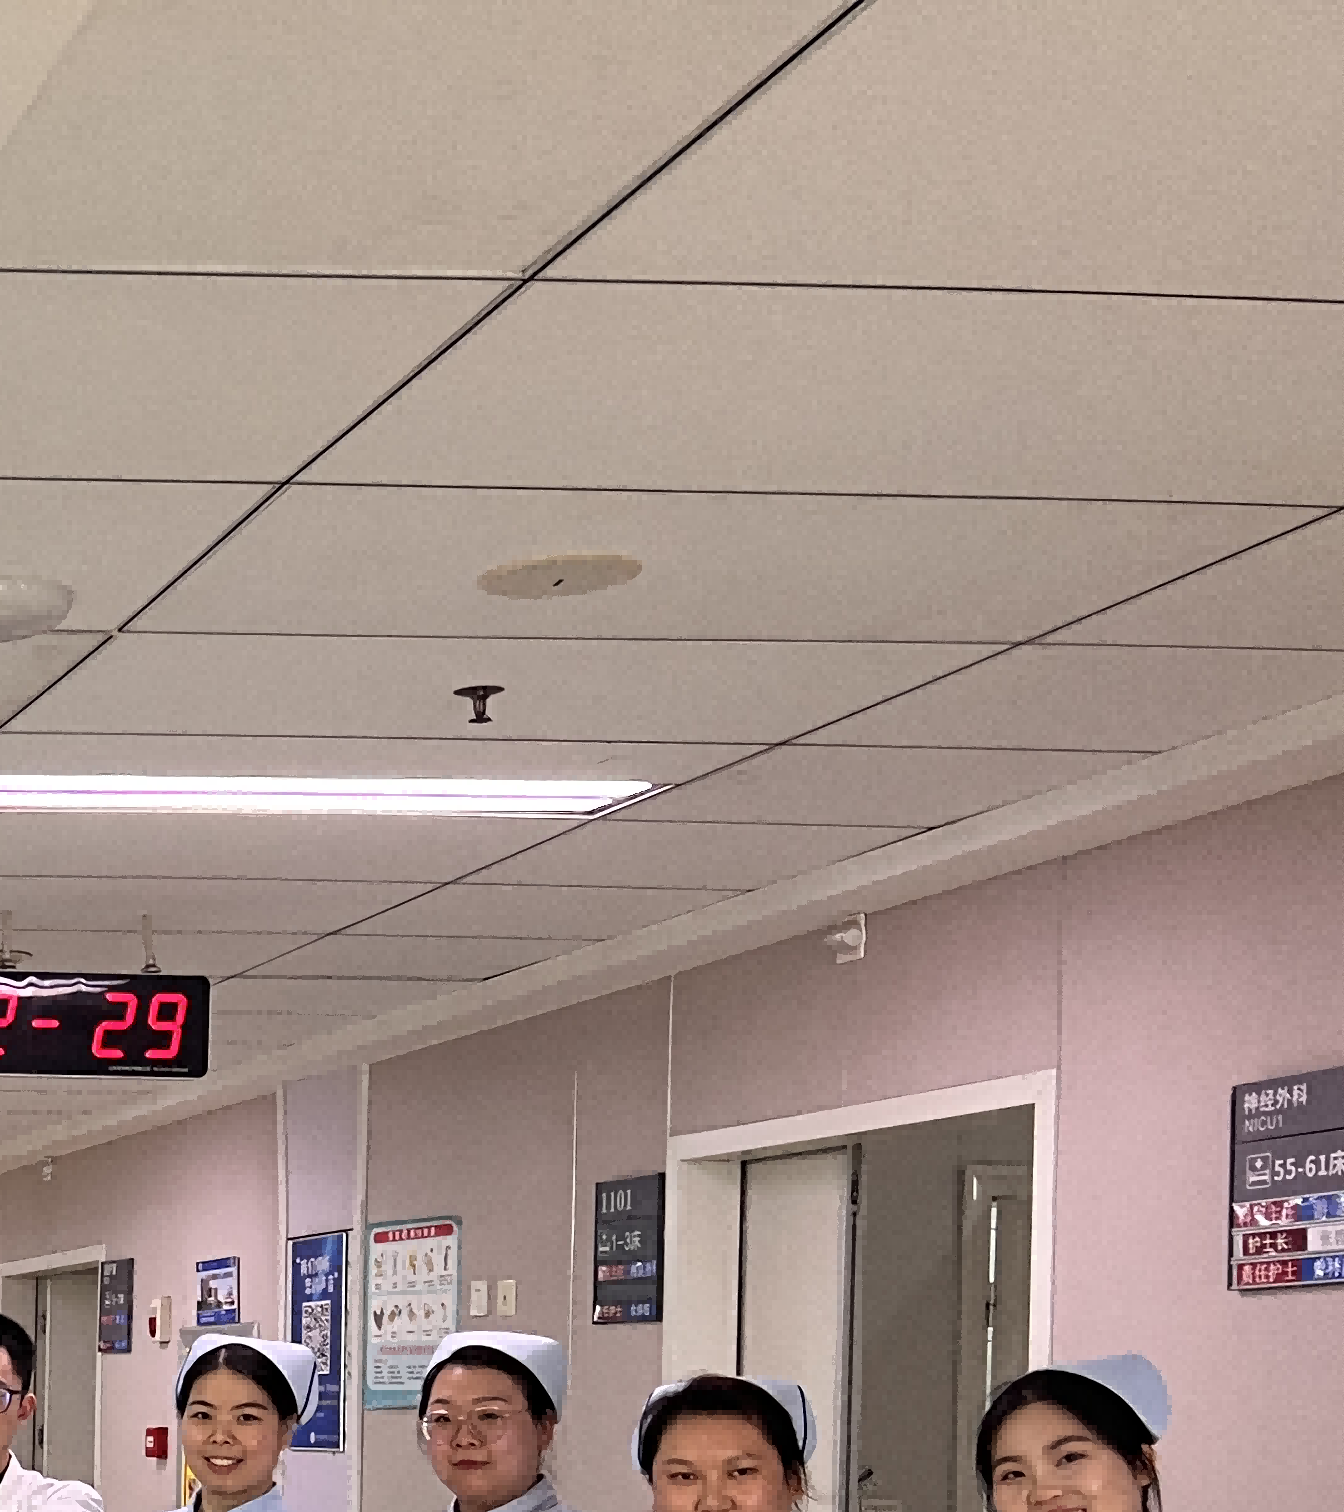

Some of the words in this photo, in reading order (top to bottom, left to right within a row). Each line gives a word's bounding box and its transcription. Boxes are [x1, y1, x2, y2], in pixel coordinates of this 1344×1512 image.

[1243, 1083, 1307, 1115] 神经外科
[1244, 1114, 1283, 1132] NICU1
[1273, 1149, 1344, 1181] 55-61床
[601, 1189, 632, 1214] 1101
[1240, 1260, 1298, 1287] 责任护士
